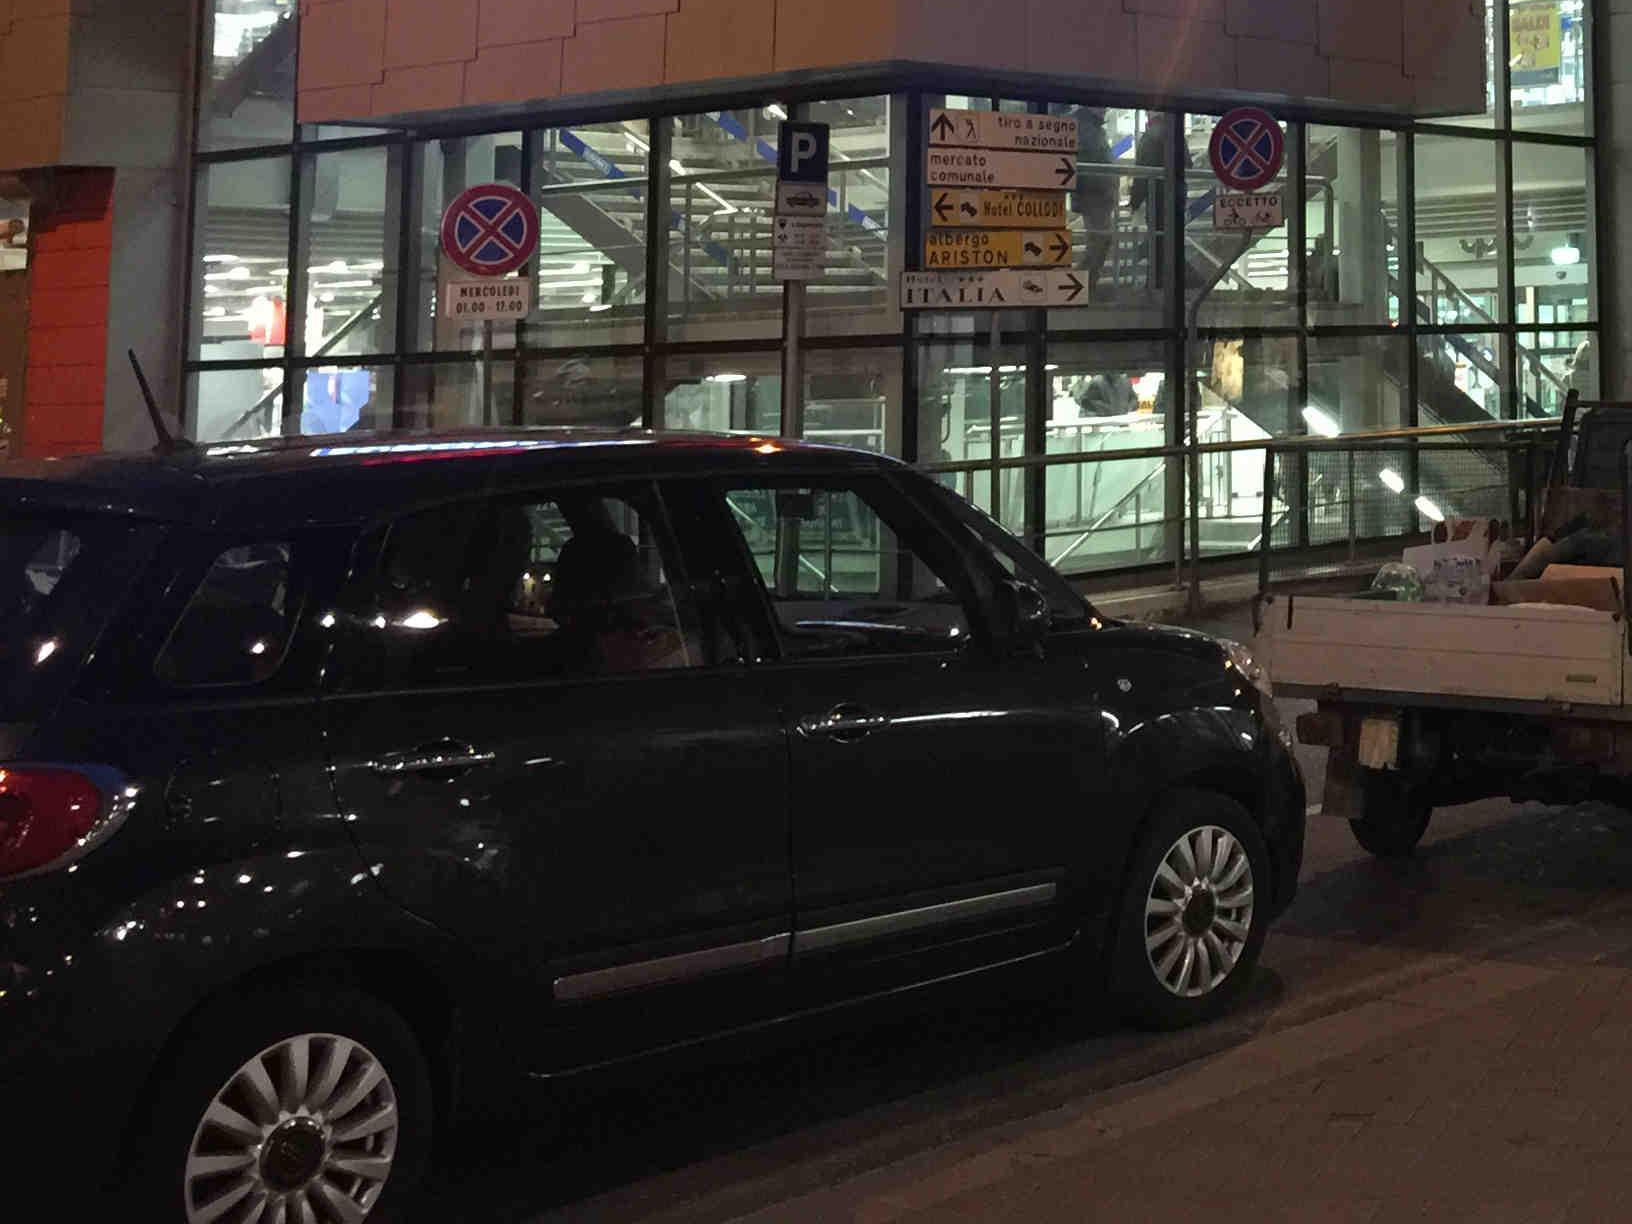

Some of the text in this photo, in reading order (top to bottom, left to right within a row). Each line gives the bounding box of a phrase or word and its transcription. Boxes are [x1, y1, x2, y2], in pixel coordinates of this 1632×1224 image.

[997, 116, 1076, 134] tiro a segno
[1014, 135, 1076, 149] nazionale
[789, 131, 817, 173] P
[929, 153, 986, 166] mercato
[930, 170, 995, 184] comunale
[983, 200, 1013, 217] Hotel
[1220, 196, 1278, 208] ECCETTO
[929, 231, 989, 248] albergo
[928, 250, 1009, 265] ARISTON
[906, 287, 1006, 304] ITALIA
